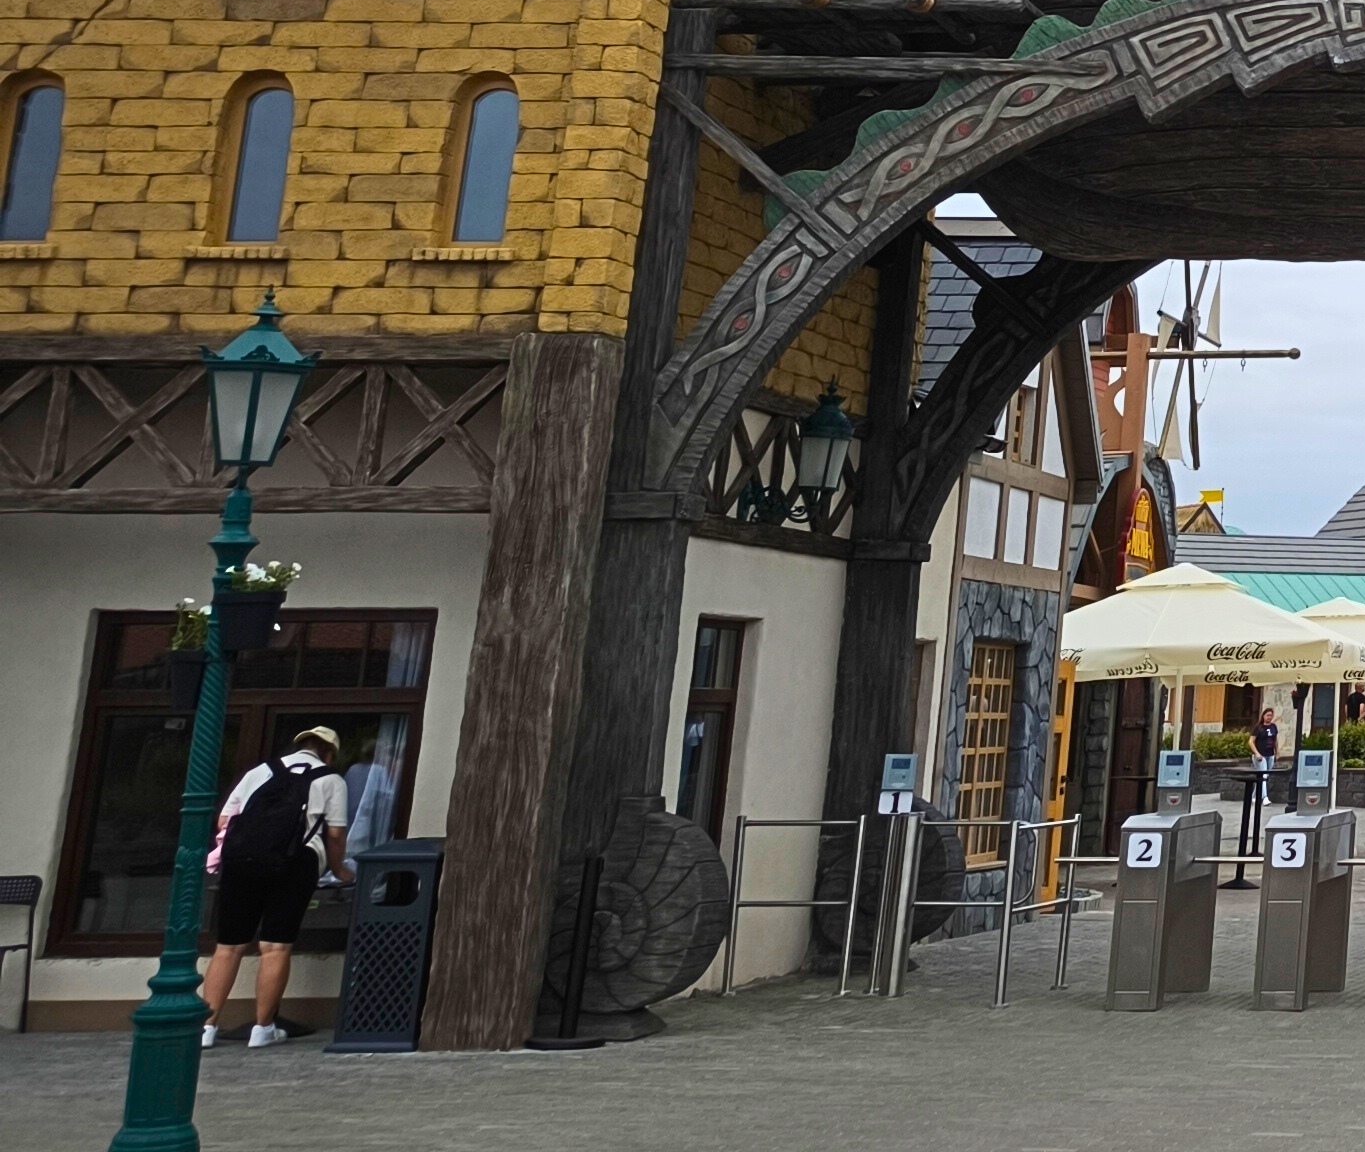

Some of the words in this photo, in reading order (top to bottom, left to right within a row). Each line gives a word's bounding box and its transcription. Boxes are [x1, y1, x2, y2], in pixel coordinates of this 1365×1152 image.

[1207, 642, 1269, 660] Coca-Cola
[1205, 671, 1250, 683] Coca-Cola
[890, 791, 901, 813] 1
[1135, 838, 1153, 862] 2
[1280, 838, 1297, 862] 3
